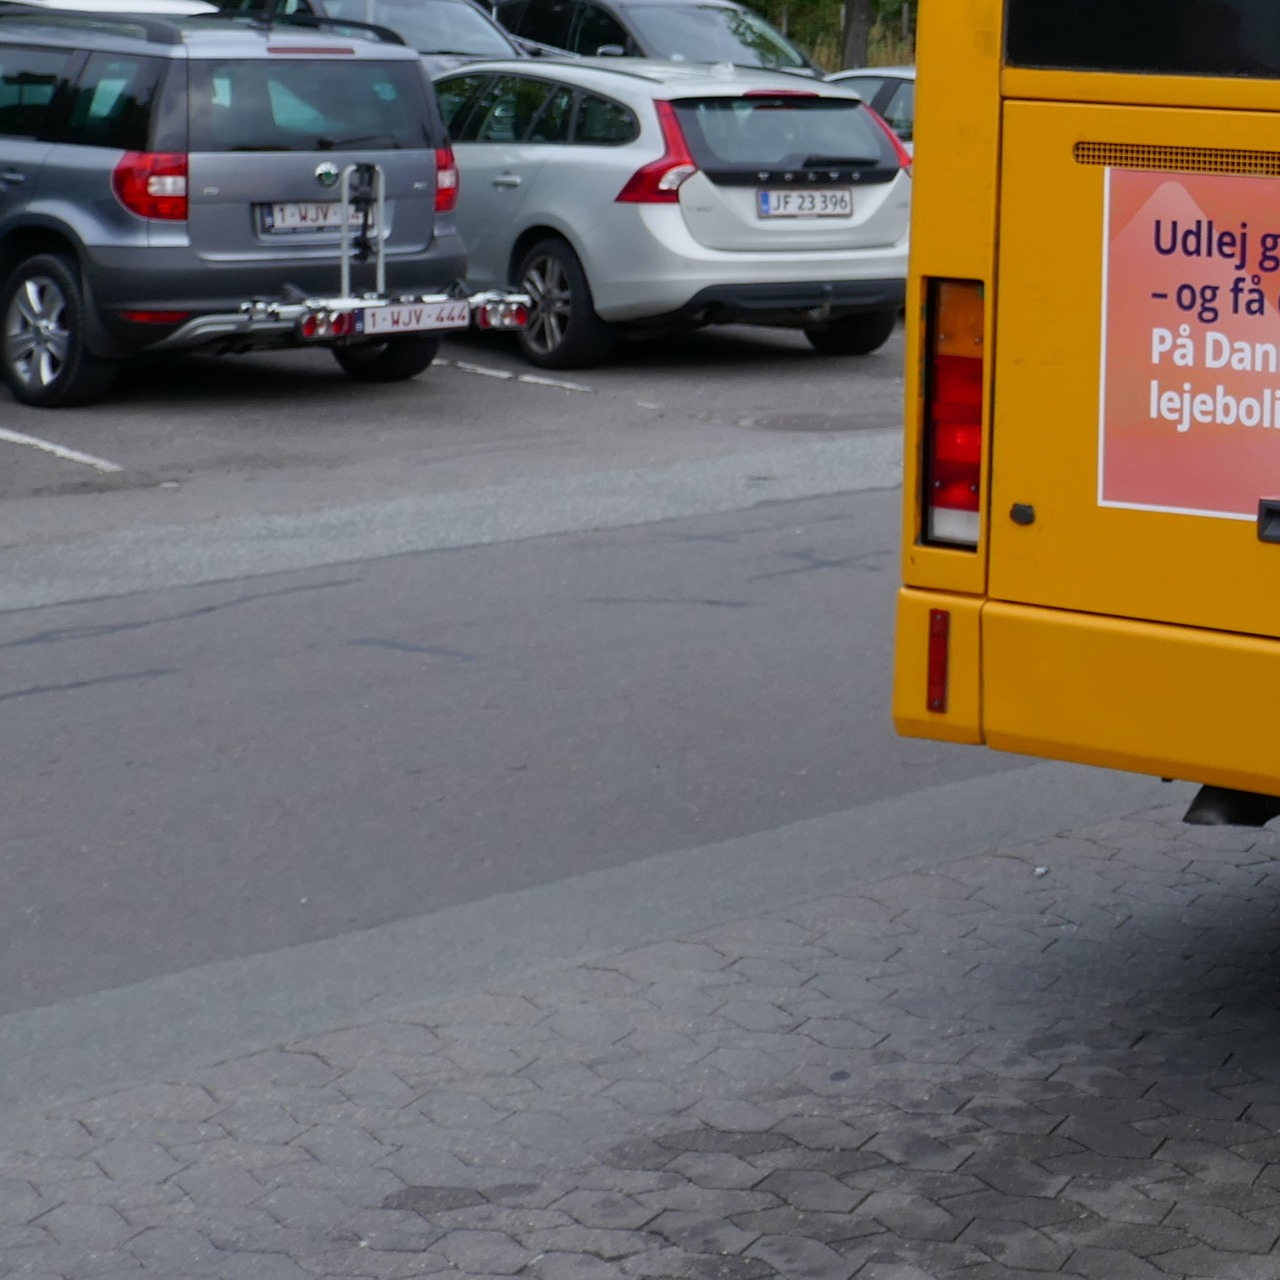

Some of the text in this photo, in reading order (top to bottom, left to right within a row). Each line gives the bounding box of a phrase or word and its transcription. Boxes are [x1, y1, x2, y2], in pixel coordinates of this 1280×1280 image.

[771, 195, 794, 211] JF
[797, 194, 816, 211] 23
[820, 193, 848, 211] 396
[1153, 219, 1248, 271] Udlej
[1229, 274, 1265, 317] få
[1151, 323, 1195, 368] På
